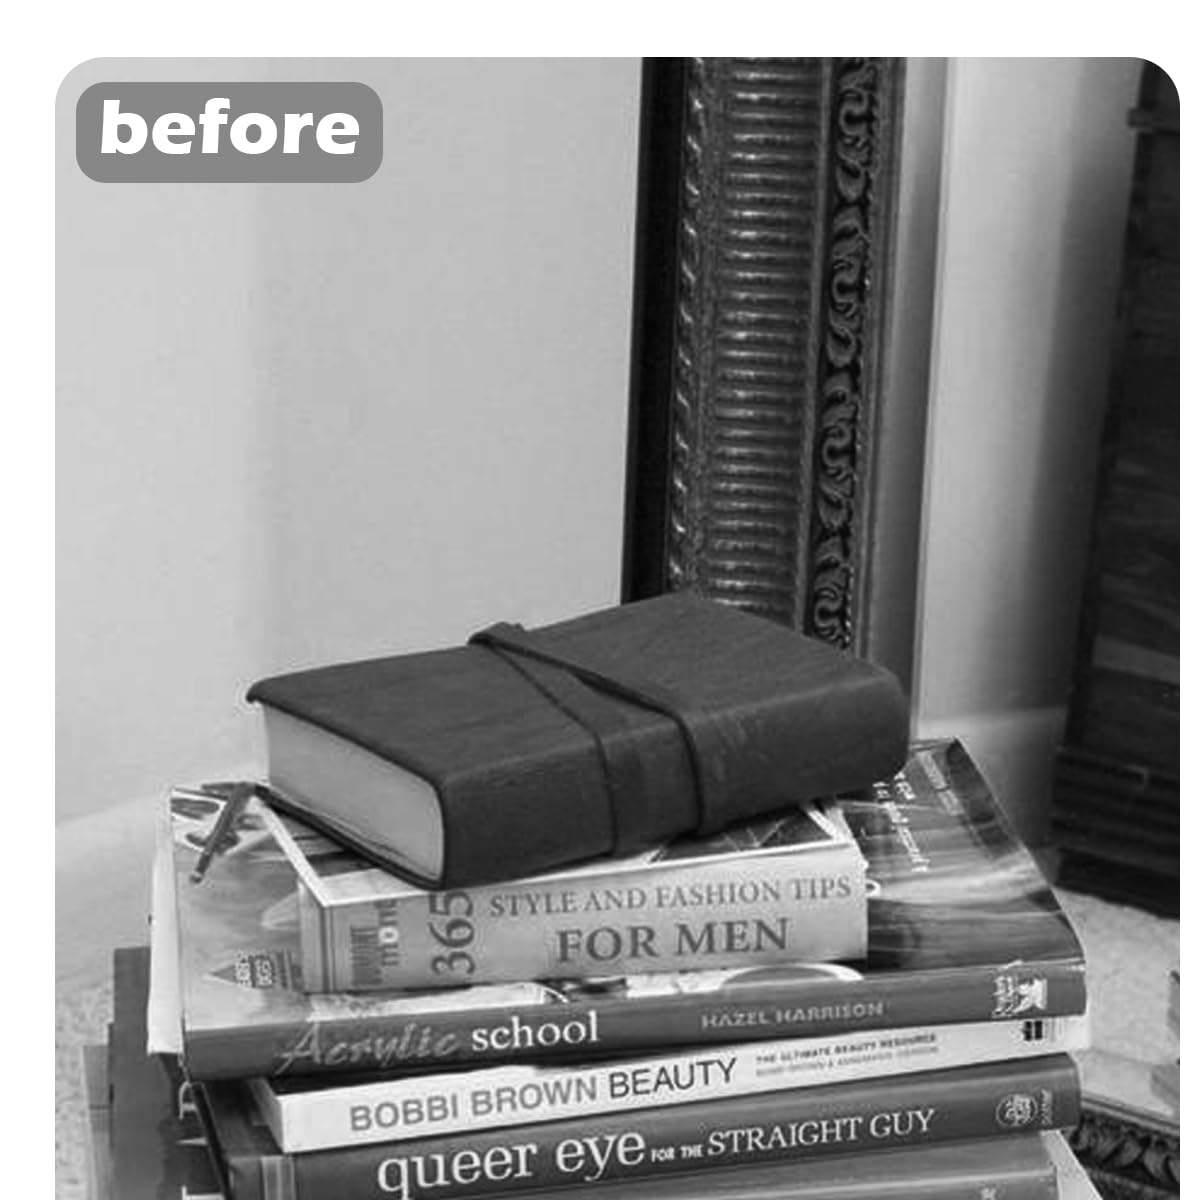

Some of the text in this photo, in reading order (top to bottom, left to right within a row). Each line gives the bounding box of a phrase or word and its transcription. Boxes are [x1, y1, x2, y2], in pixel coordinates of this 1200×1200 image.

[490, 876, 852, 917] STYLE AND FASHION TIPS
[428, 891, 476, 975] 365
[555, 917, 790, 964] FOR MEN
[275, 1011, 599, 1075] Acrylic school
[701, 1002, 885, 1031] HAZEL HARRISON
[350, 1058, 737, 1133] BOBBI BROWN BEAUTY
[377, 1109, 935, 1200] queer eye FOR THE STRAIGHT GUY
